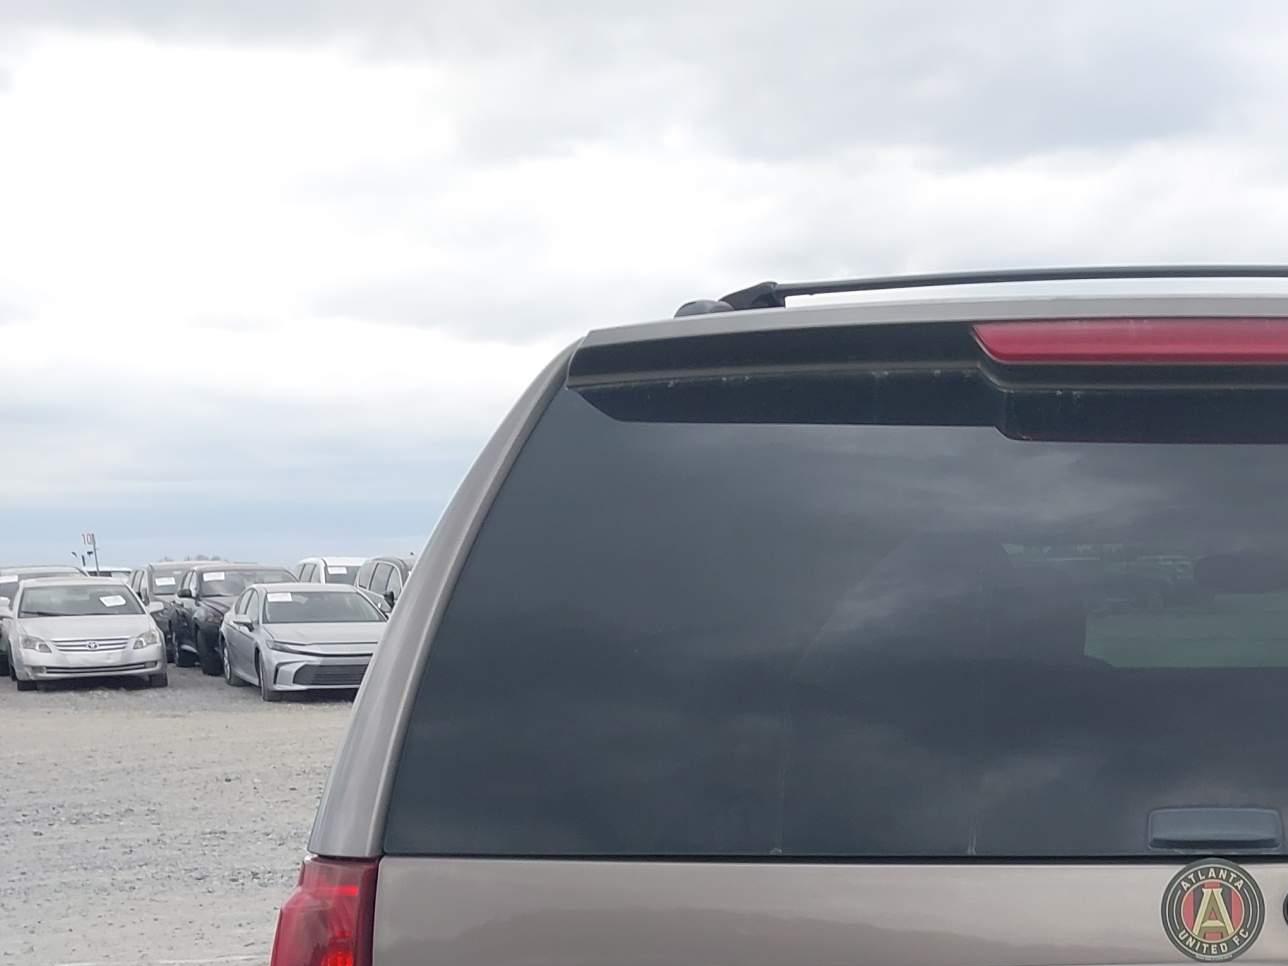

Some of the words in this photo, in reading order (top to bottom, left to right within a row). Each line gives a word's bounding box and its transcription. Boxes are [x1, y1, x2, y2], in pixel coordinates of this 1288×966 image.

[1180, 867, 1244, 891] ATLANTA
[1178, 928, 1228, 954] UNITED
[1234, 928, 1249, 946] FC
